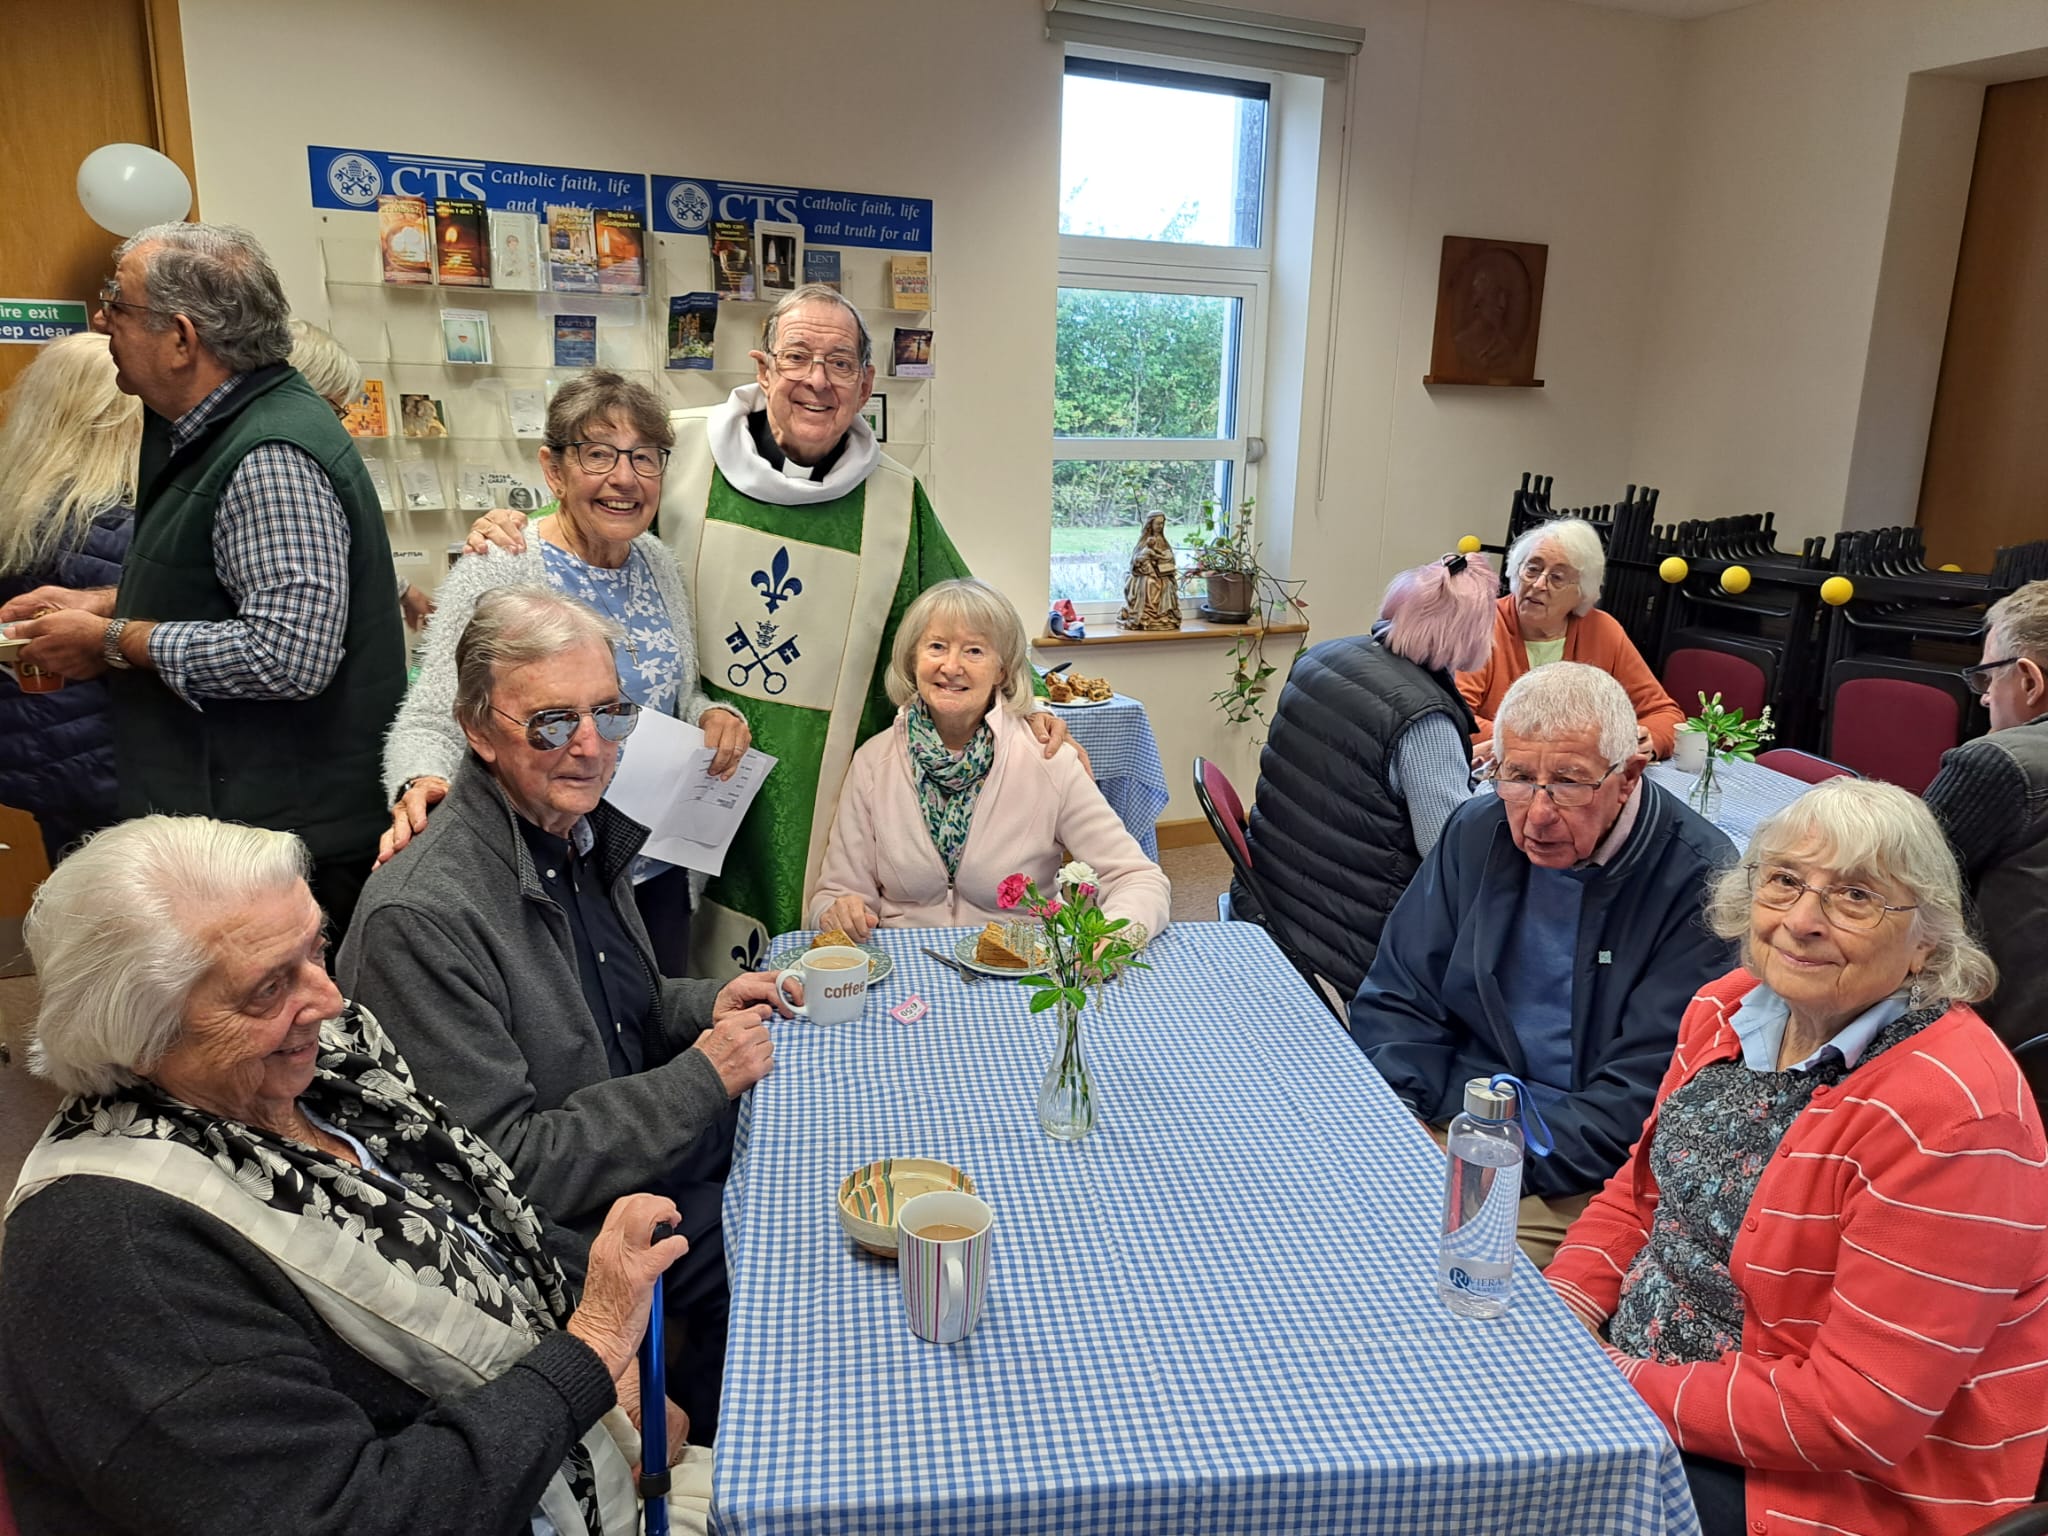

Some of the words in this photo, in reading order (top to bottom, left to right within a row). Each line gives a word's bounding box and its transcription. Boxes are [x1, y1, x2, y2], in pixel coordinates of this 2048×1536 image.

[391, 166, 486, 200] CTS
[490, 169, 557, 189] Catholic
[608, 178, 631, 197] life
[506, 198, 537, 213] and
[719, 193, 799, 224] CTS
[802, 196, 857, 213] Catholic
[901, 203, 920, 220] life
[607, 211, 629, 220] Being
[814, 222, 841, 237] and
[844, 224, 876, 239] truth
[880, 228, 899, 242] for
[903, 228, 920, 242] all
[0, 305, 22, 318] ire
[28, 307, 60, 320] exit
[30, 324, 73, 337] clear
[824, 981, 865, 999] coffee
